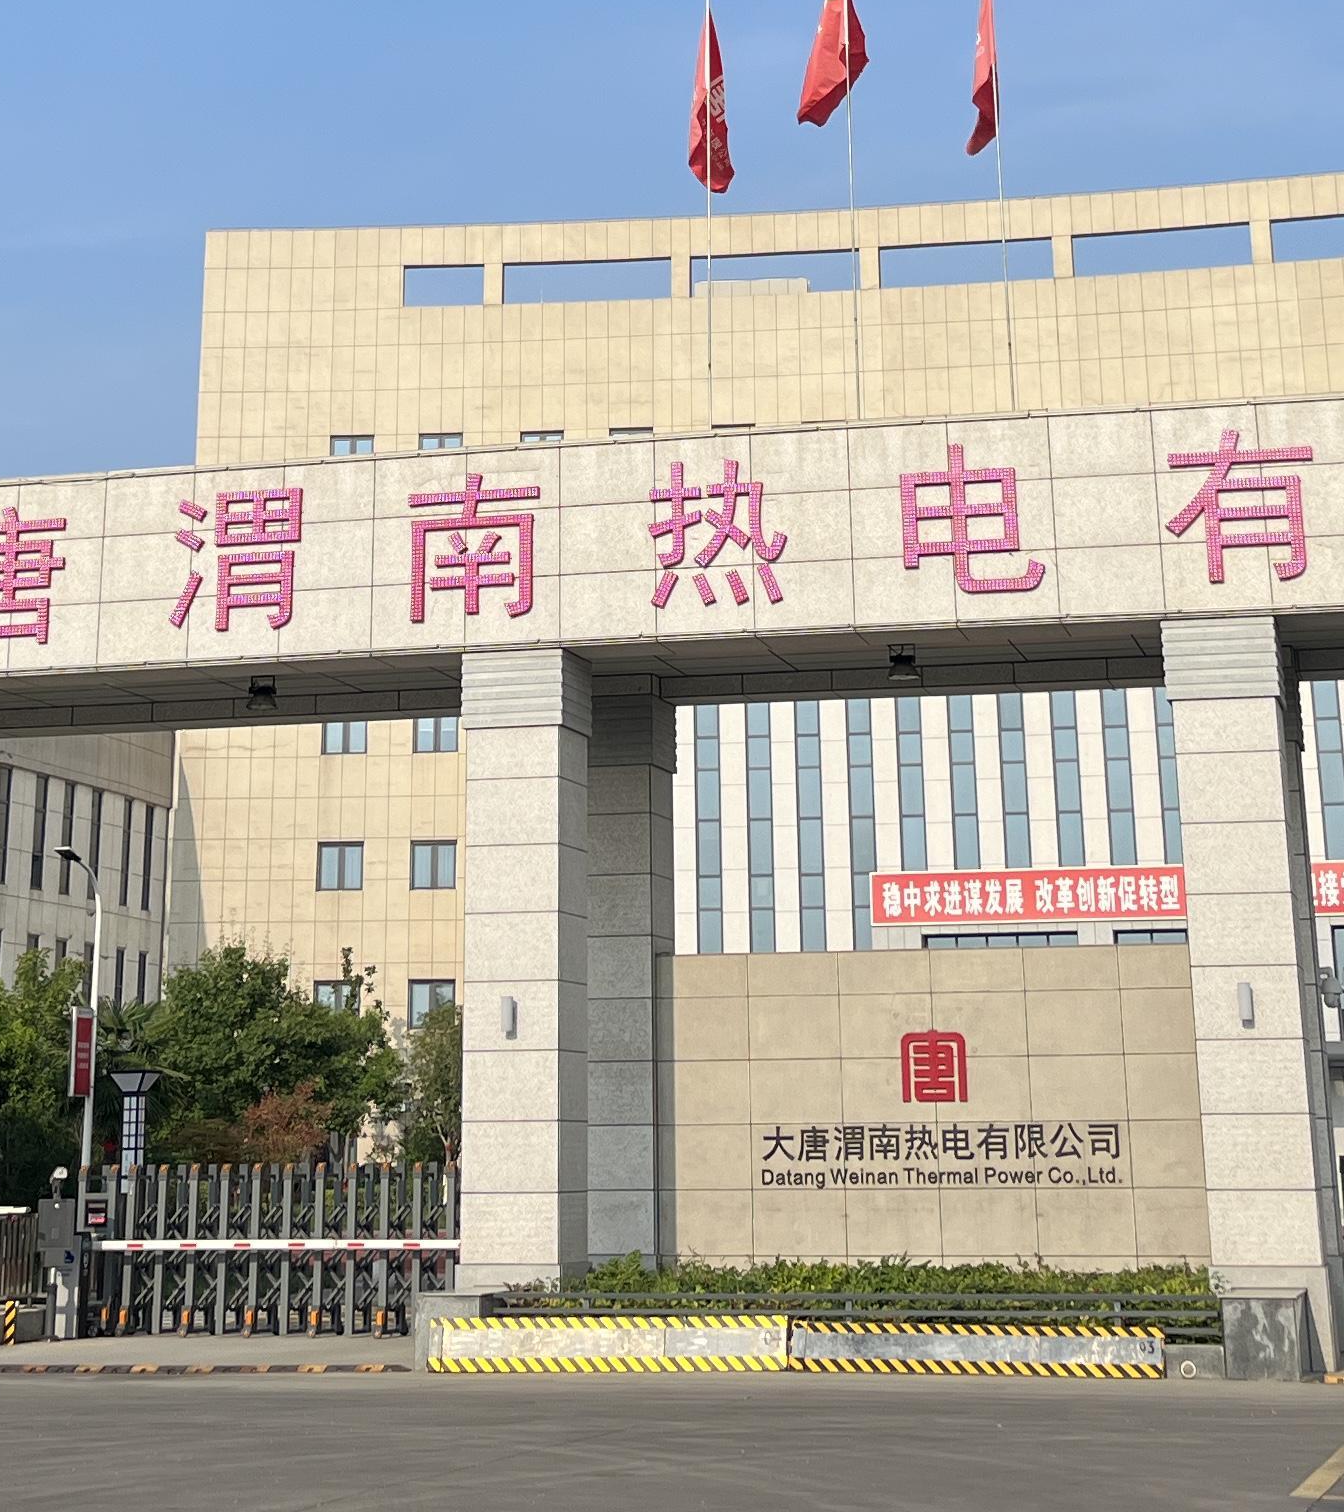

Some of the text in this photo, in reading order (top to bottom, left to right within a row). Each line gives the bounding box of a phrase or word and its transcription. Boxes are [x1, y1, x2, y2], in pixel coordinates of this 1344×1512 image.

[882, 874, 1181, 918] 稳中求进谋发展 改革创新促转型
[762, 1122, 1121, 1162] 大唐渭南热电有限公司
[761, 1166, 1124, 1189] Datang Weinan Thermal Power Co.,Ltd.
